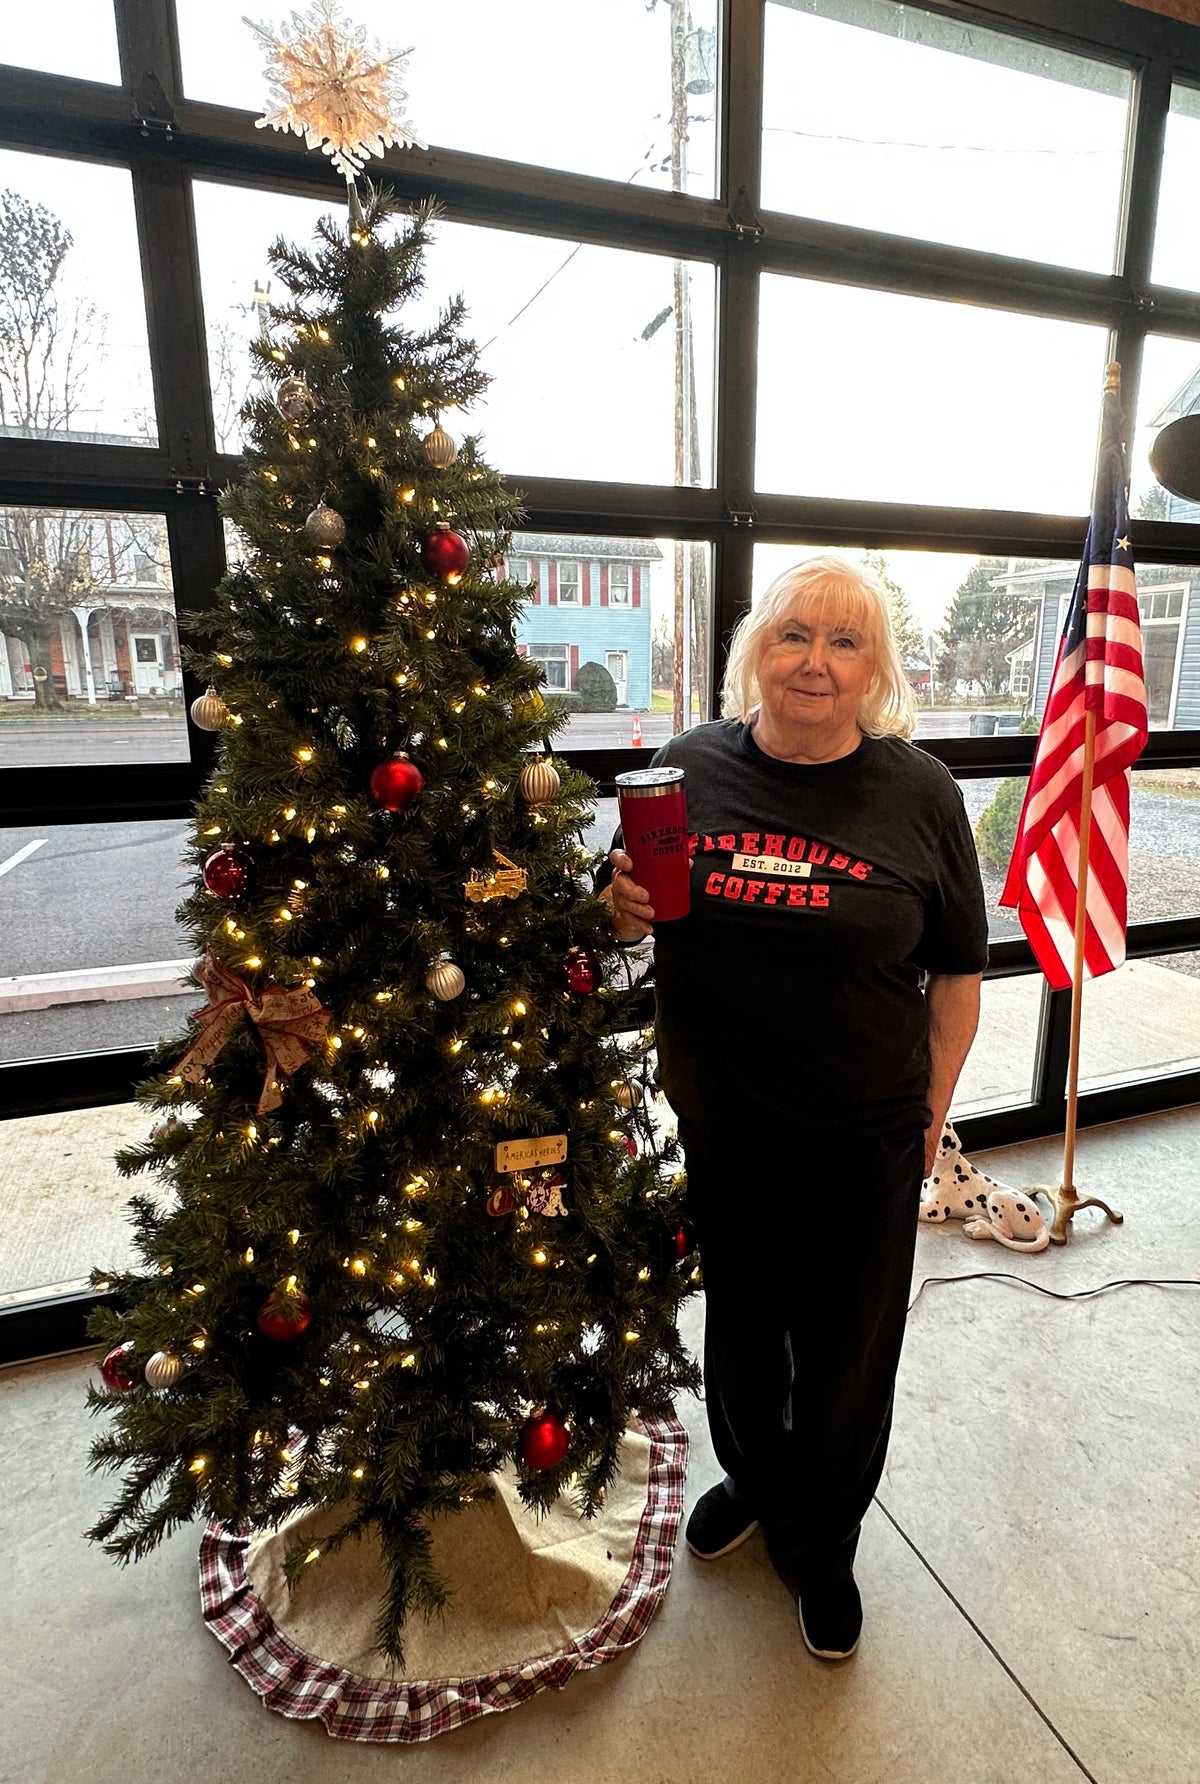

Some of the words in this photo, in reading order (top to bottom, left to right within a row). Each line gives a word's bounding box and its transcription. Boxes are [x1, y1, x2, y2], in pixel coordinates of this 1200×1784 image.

[742, 858, 767, 872] EST.
[773, 861, 802, 874] 2012
[705, 872, 830, 907] COFFEE
[505, 1148, 538, 1161] AMERICAS
[539, 1146, 561, 1157] HEROES
